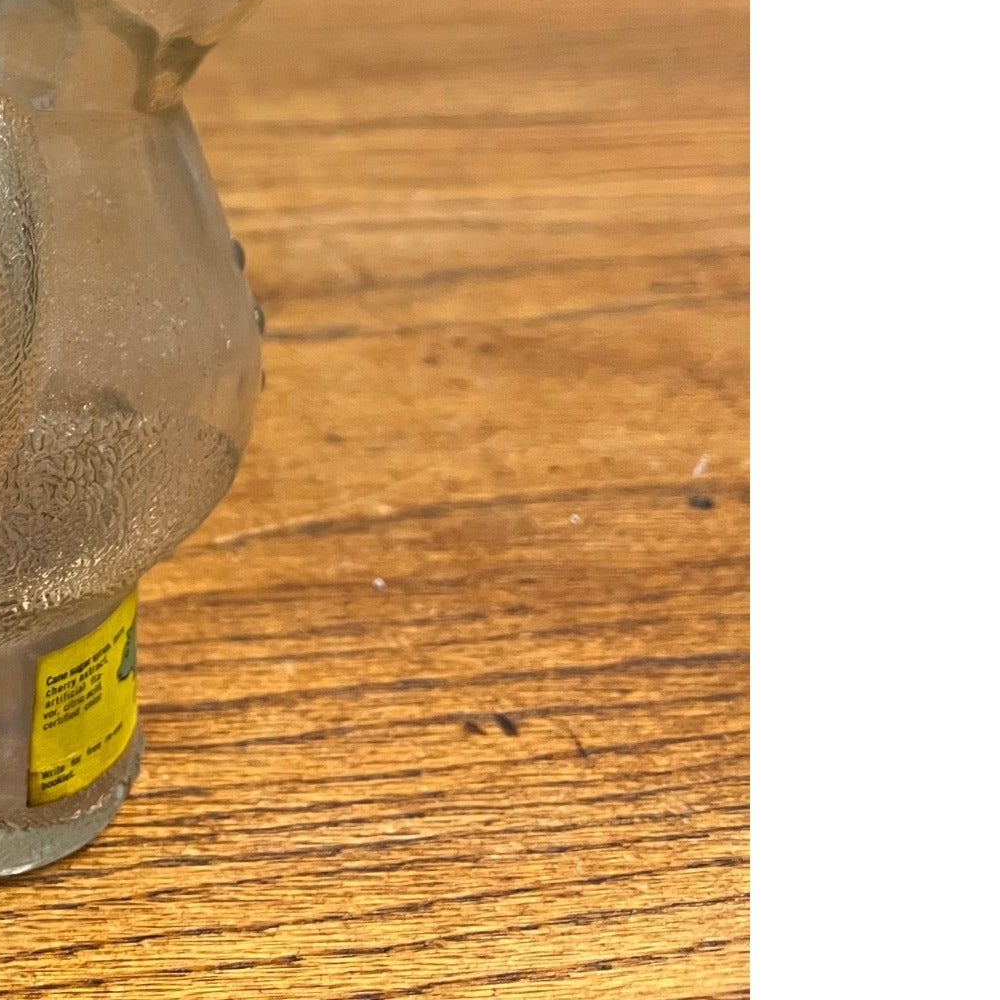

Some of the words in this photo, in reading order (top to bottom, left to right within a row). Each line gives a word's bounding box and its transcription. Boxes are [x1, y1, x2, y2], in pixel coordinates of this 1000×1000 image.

[45, 682, 86, 709] artificial
[46, 679, 77, 697] cherry
[43, 707, 80, 731] certified
